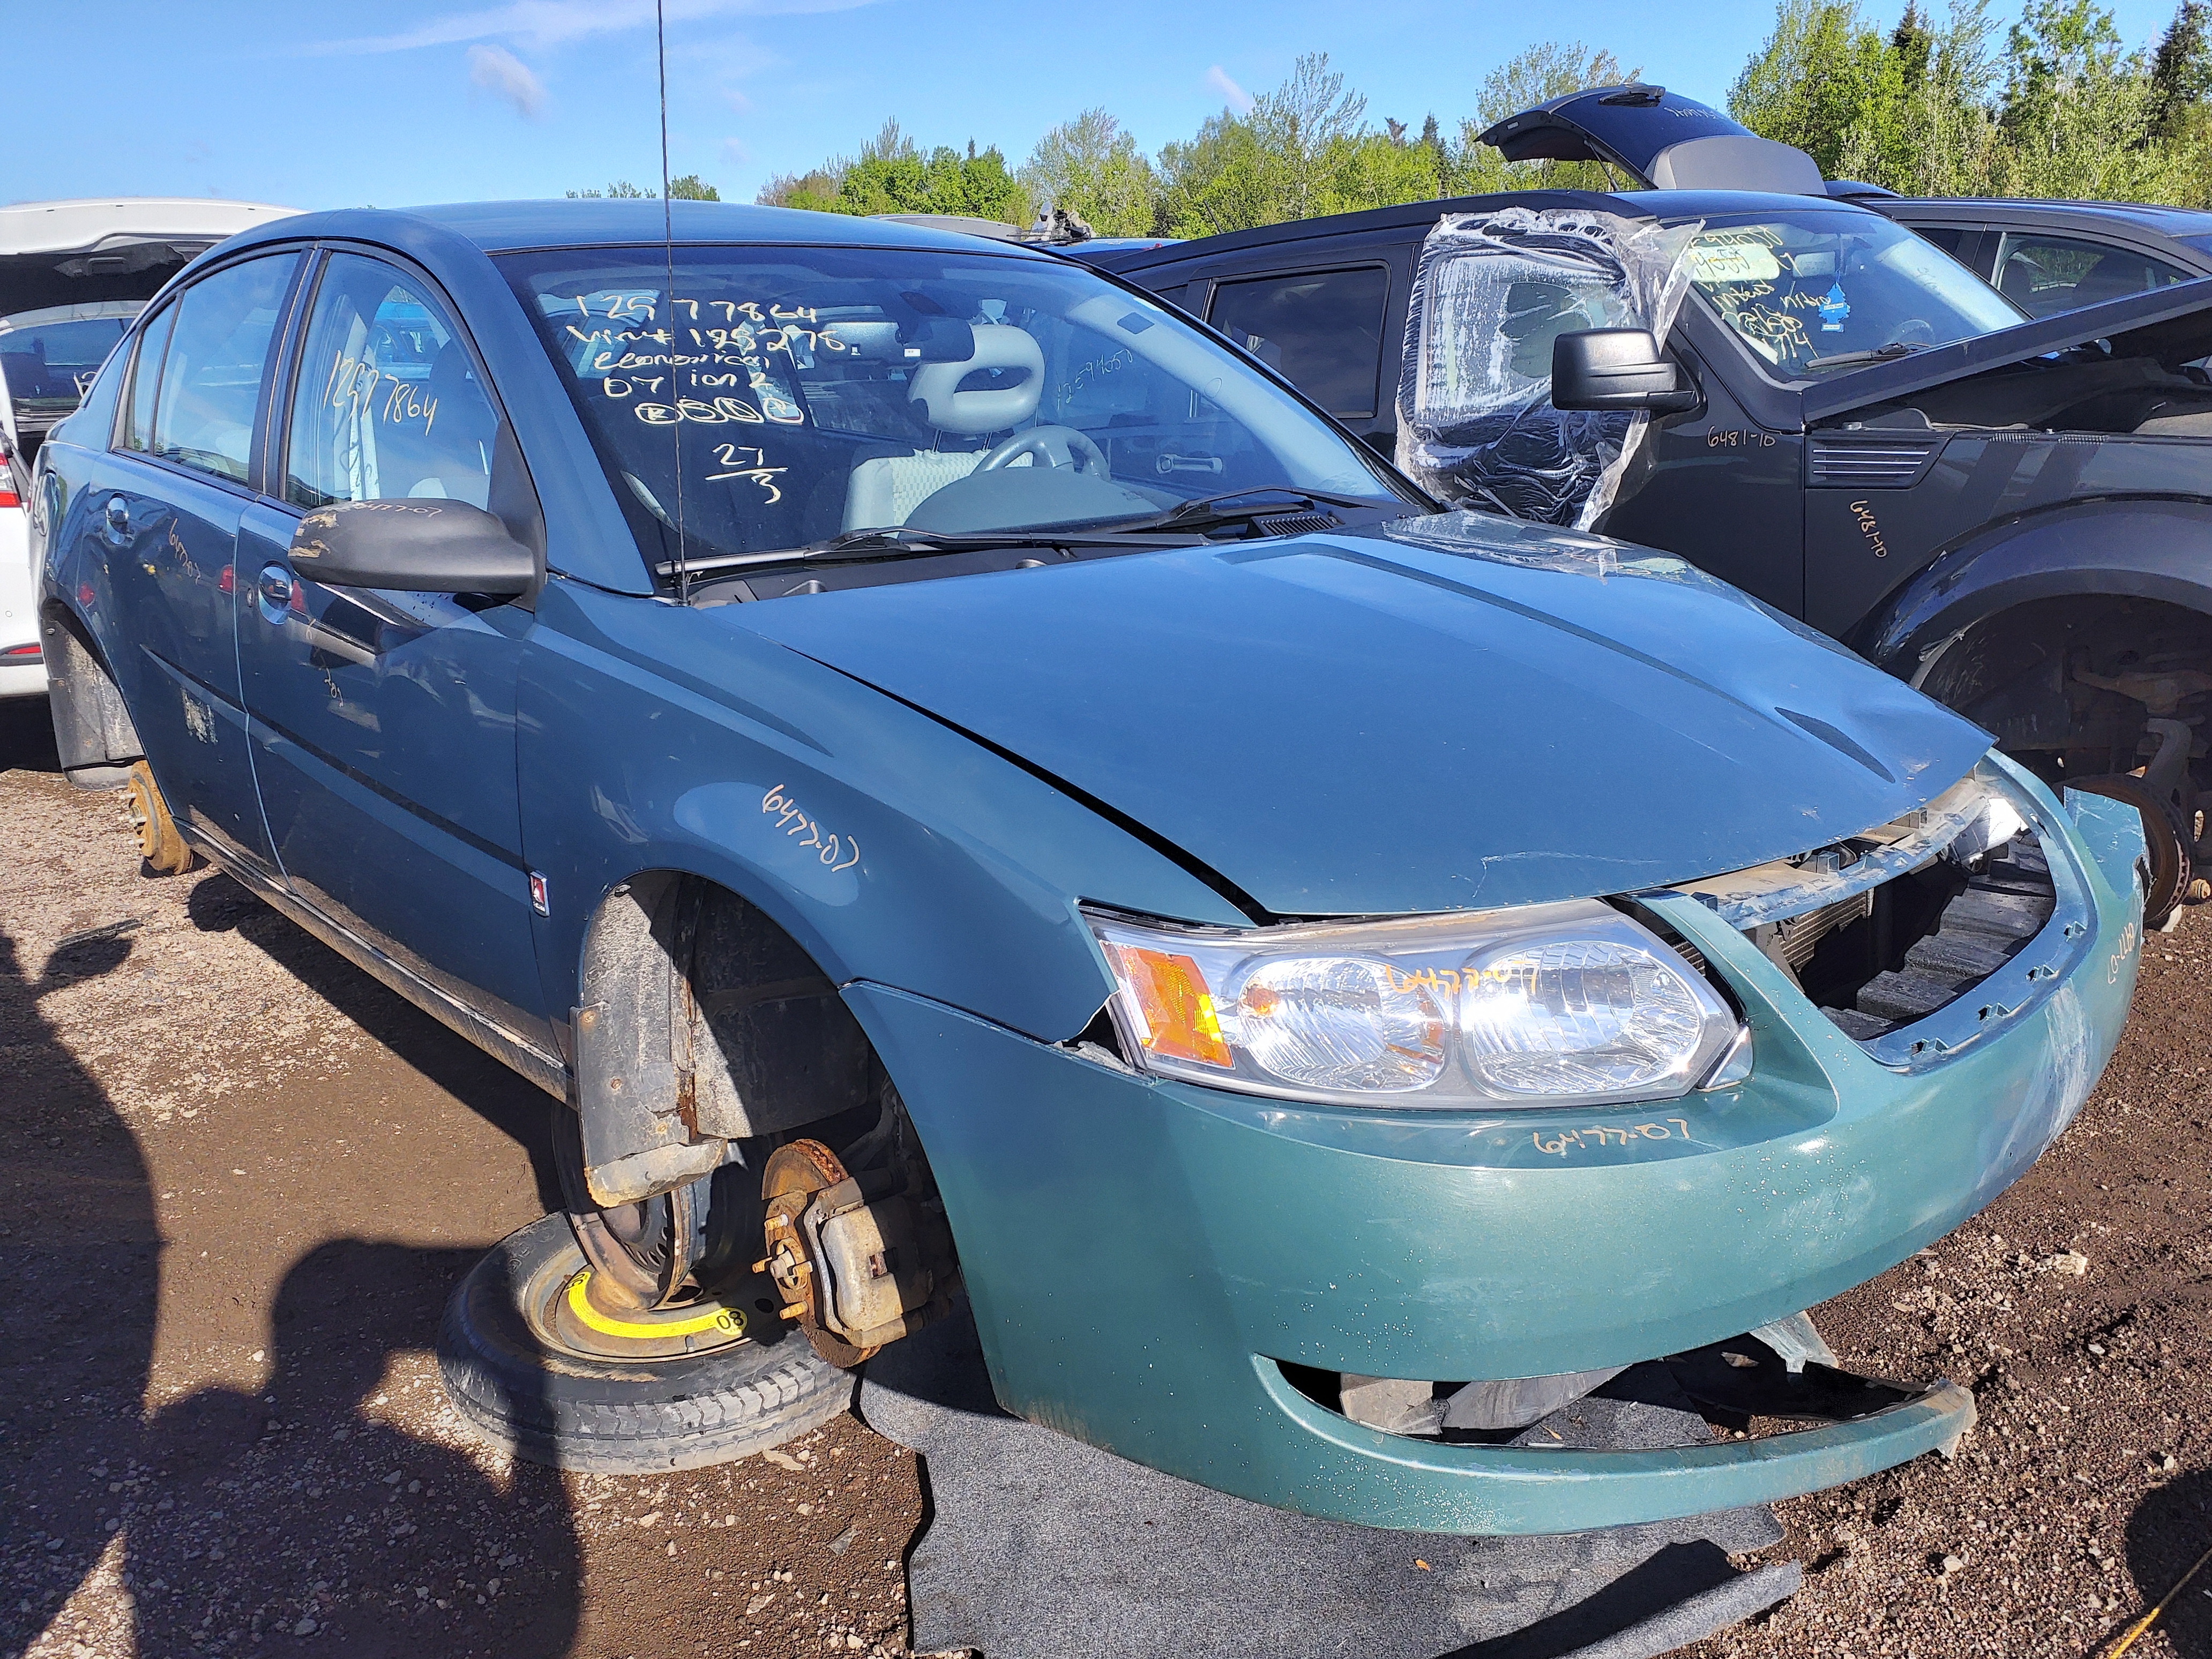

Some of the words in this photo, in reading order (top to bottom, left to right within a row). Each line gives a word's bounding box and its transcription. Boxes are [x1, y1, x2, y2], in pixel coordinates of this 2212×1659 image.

[1708, 425, 1776, 447] 6481-10
[1849, 500, 1888, 558] 6481-10
[1532, 1118, 1690, 1154] 6477-07
